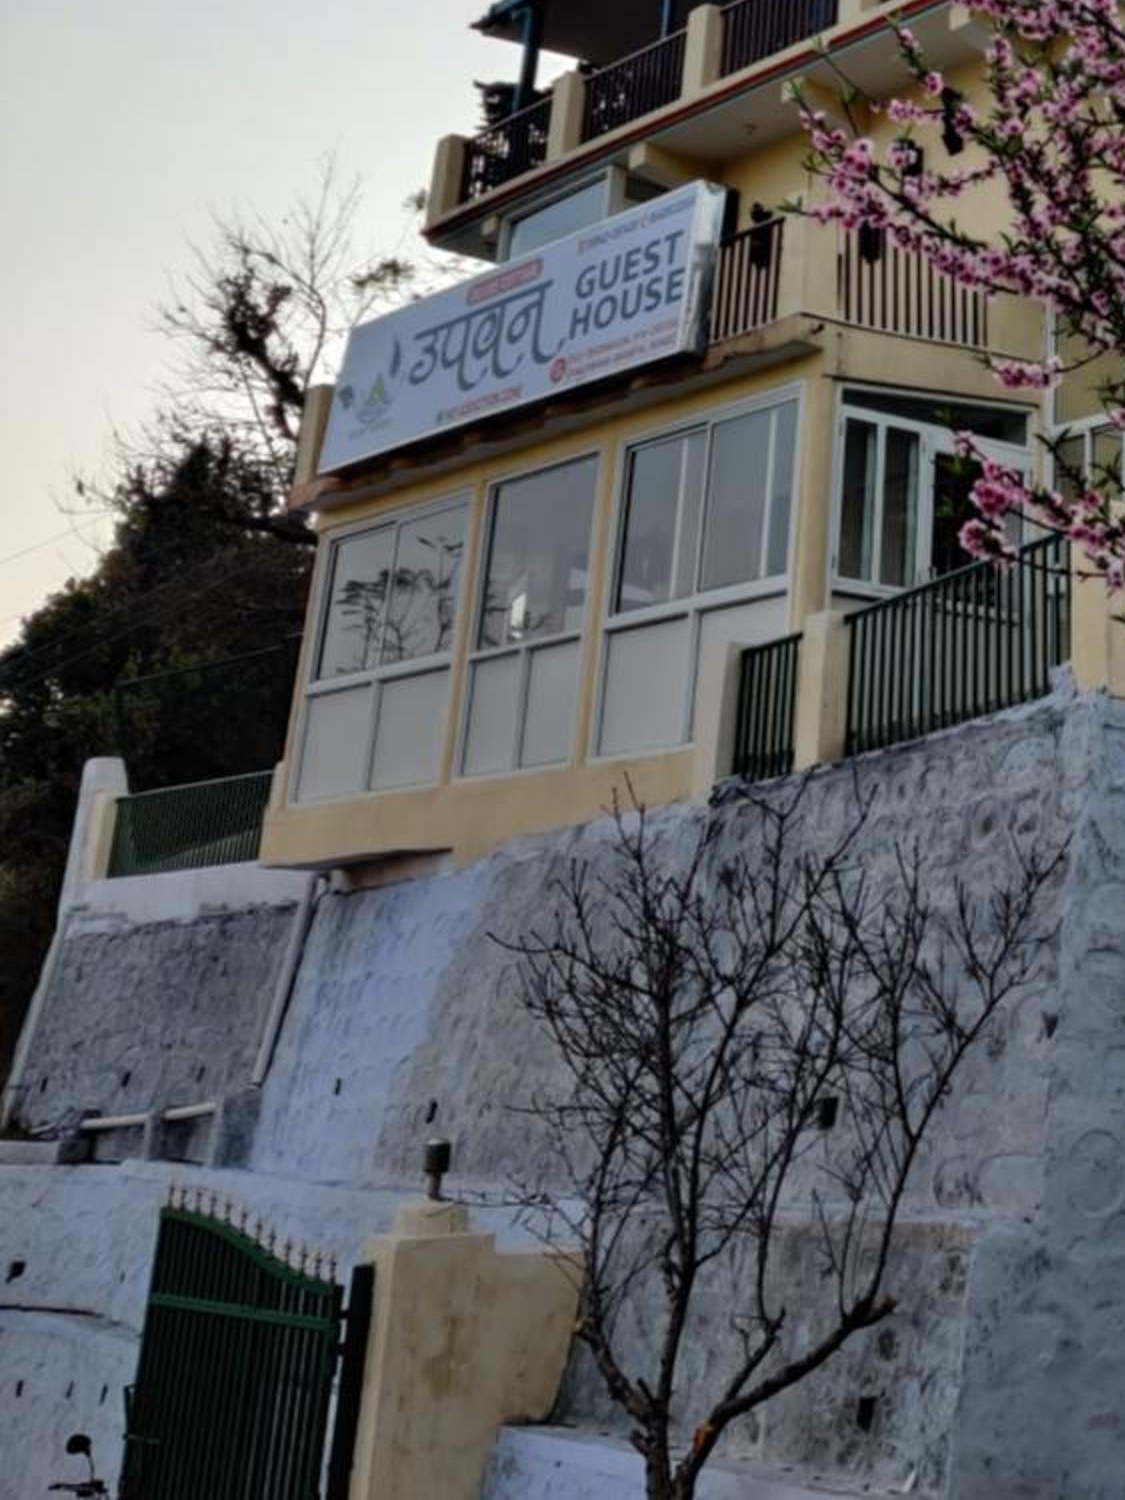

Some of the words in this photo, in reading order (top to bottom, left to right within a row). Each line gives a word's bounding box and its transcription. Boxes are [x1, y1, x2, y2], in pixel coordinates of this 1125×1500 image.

[575, 229, 684, 299] GUEST
[408, 279, 566, 391] उपवन
[568, 266, 686, 341] HOUSE
